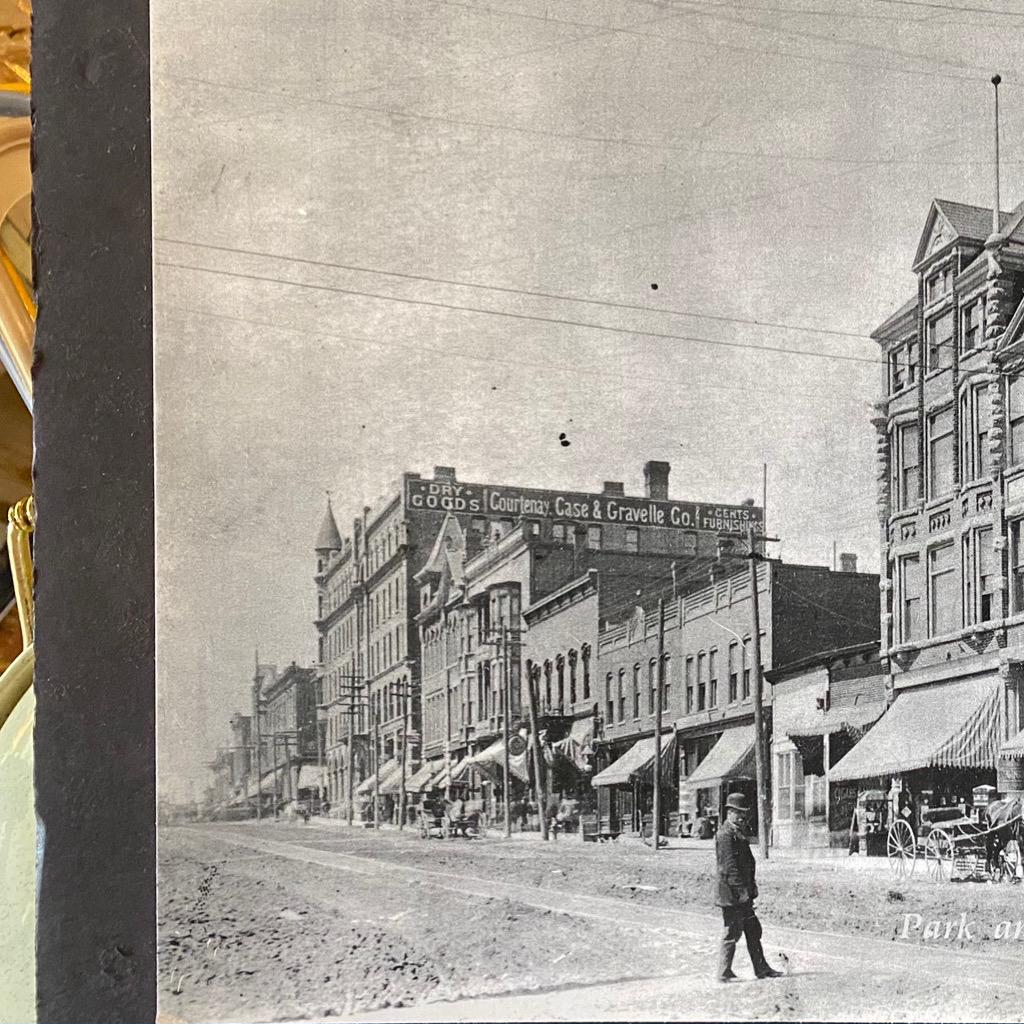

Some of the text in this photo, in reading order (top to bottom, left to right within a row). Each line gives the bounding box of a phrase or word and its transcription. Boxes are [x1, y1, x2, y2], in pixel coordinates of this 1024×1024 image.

[429, 484, 463, 496] DRY
[412, 495, 480, 511] GOODS
[555, 496, 589, 518] Case
[592, 500, 602, 519] &
[607, 501, 664, 524] Gravelle
[671, 506, 695, 526] Co.
